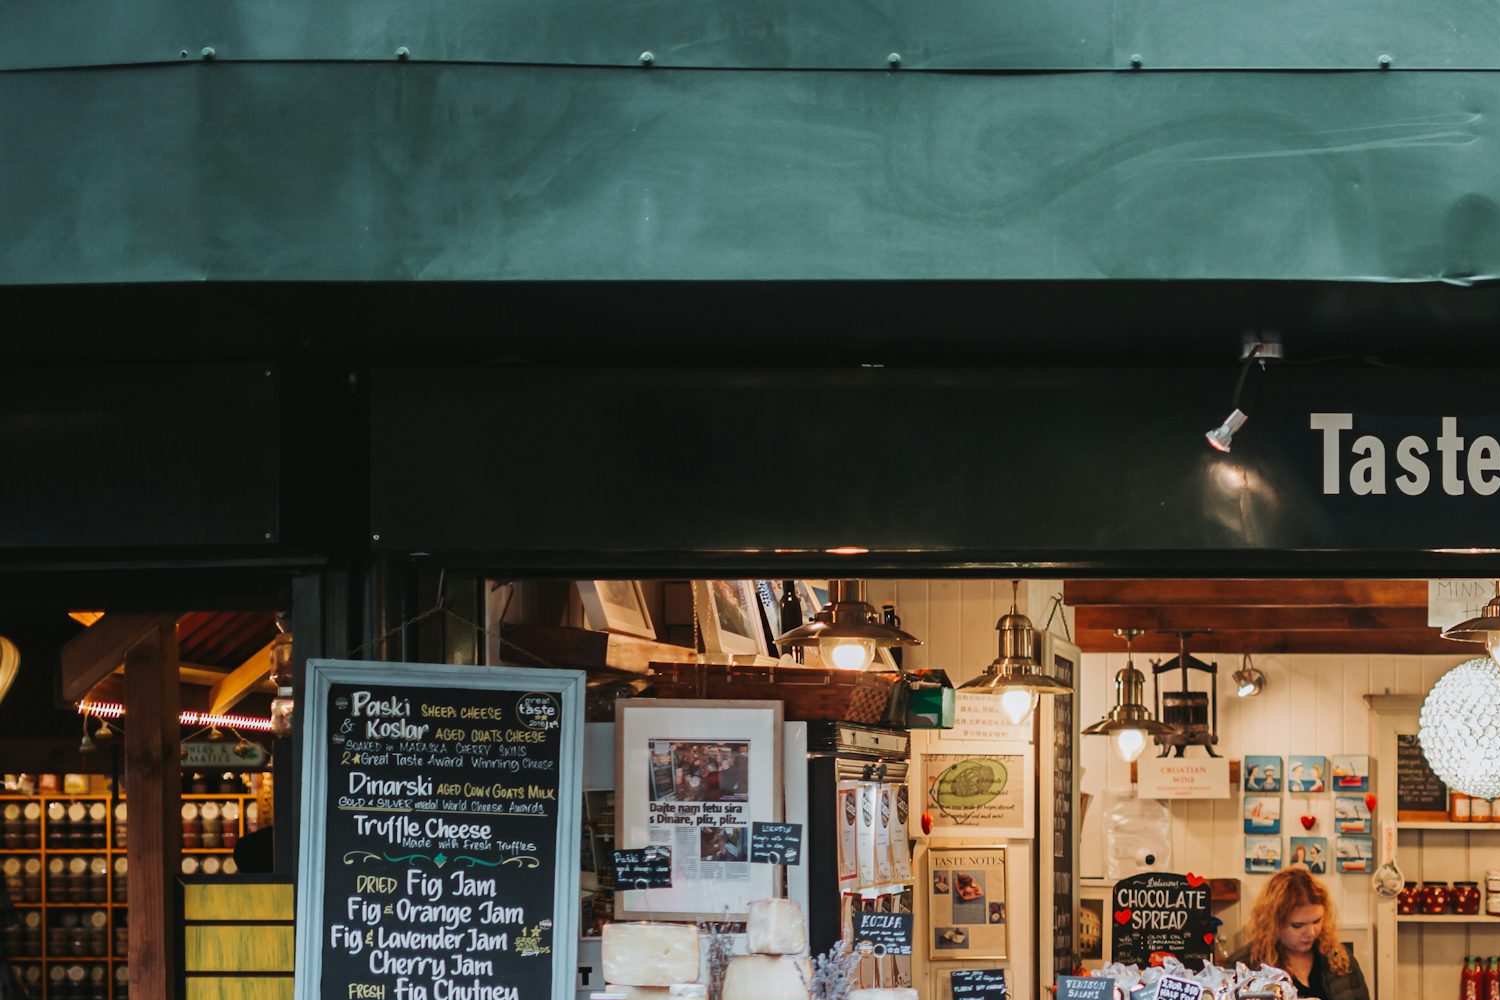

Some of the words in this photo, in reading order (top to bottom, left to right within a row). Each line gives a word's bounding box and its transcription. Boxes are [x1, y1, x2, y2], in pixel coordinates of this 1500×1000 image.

[351, 690, 411, 718] Paski
[519, 704, 555, 716] taste
[340, 719, 354, 734] &
[366, 719, 430, 740] Koslar
[435, 728, 466, 742] AGED
[470, 729, 503, 743] GOATS
[505, 730, 546, 744] CHEESE
[361, 752, 388, 766] Great
[392, 753, 423, 766] Taste
[427, 754, 464, 768] Award
[471, 756, 520, 772] Winning
[522, 758, 554, 770] Cheese
[1160, 766, 1206, 774] CROATIAN
[349, 772, 432, 797] Dinarski
[649, 803, 675, 814] Dajte
[678, 806, 700, 814] nam
[703, 803, 721, 813] fetu
[725, 803, 742, 813] sira
[354, 814, 422, 844] Truffle
[424, 818, 492, 840] Cheese
[649, 815, 655, 823] s
[657, 815, 694, 825] Dinare,
[696, 814, 716, 826] pliz,
[720, 814, 747, 826] pliz...
[402, 838, 432, 848] Made
[438, 838, 458, 850] with
[463, 840, 492, 850] Fresh
[496, 840, 536, 852] Truffles
[933, 857, 966, 866] TASTE
[967, 857, 1004, 865] NOTES
[356, 876, 398, 894] DRIED
[406, 870, 444, 902] Fig
[451, 870, 496, 898] Jam
[1117, 888, 1206, 909] CHOCOLATE
[348, 897, 382, 924] Fig
[396, 898, 472, 930] Orange
[479, 901, 524, 924] Jam
[1132, 910, 1188, 930] SPREAD
[330, 924, 363, 954] Fig
[378, 927, 465, 951] Lavender
[466, 928, 508, 952] Jam
[368, 950, 446, 980] Cherry
[450, 954, 494, 977] Jam
[348, 984, 386, 1000] FRESH
[1066, 980, 1106, 990] VENISON
[1068, 990, 1099, 999] SALAMI
